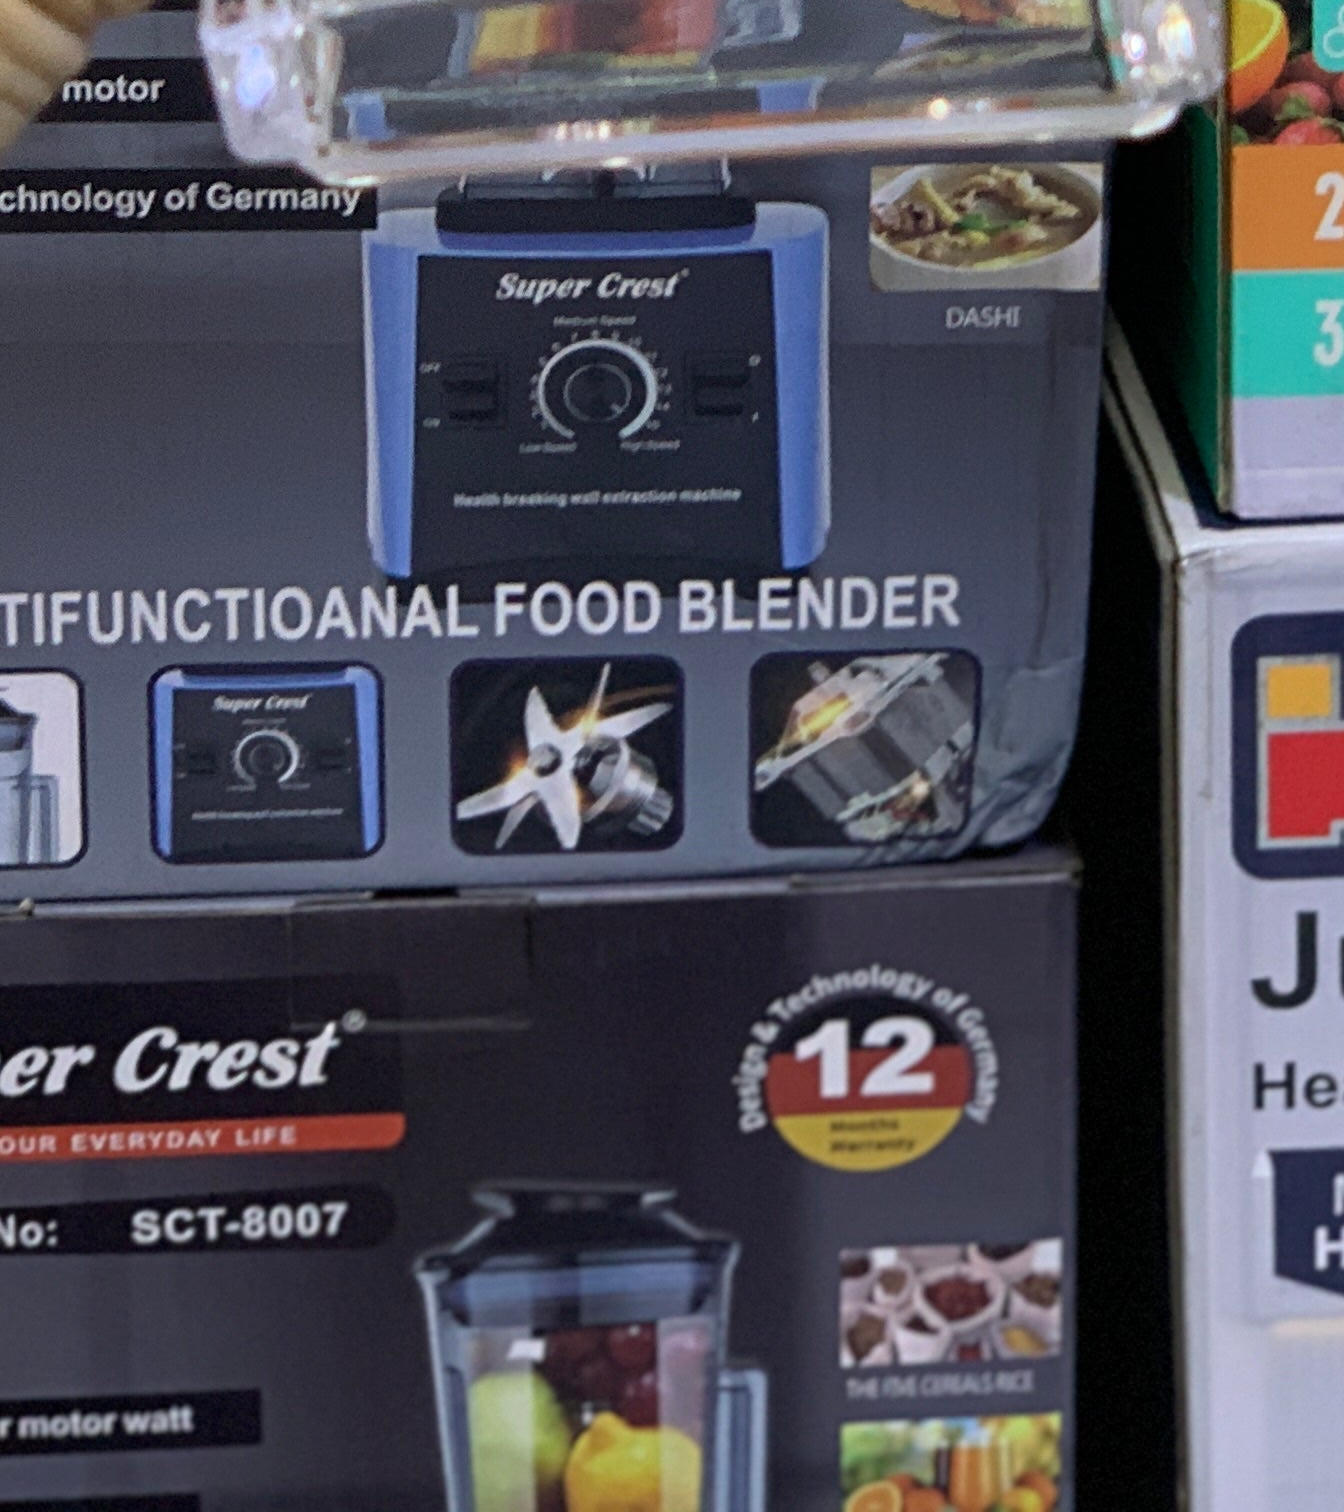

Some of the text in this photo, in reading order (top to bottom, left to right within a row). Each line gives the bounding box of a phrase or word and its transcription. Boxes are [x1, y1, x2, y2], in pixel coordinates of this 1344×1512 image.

[61, 75, 165, 104] motor
[164, 183, 200, 209] of
[206, 183, 360, 216] Germany
[496, 271, 679, 304] Super Crest
[945, 305, 1023, 329] DASHI
[453, 487, 742, 508] Health breaking wall extraction machine
[494, 581, 662, 637] FOOD
[678, 574, 962, 634] BLENDER
[113, 1019, 340, 1094] Crest
[731, 1042, 769, 1134] Design
[765, 963, 935, 1023] Technology
[931, 987, 971, 1015] of
[957, 1006, 999, 1125] Germany
[795, 1015, 935, 1099] 12
[70, 1128, 222, 1153] EVERYDAY
[235, 1125, 299, 1147] LIFE
[130, 1201, 348, 1245] SCT-8007
[18, 1410, 115, 1440] motor
[123, 1405, 194, 1435] watt
